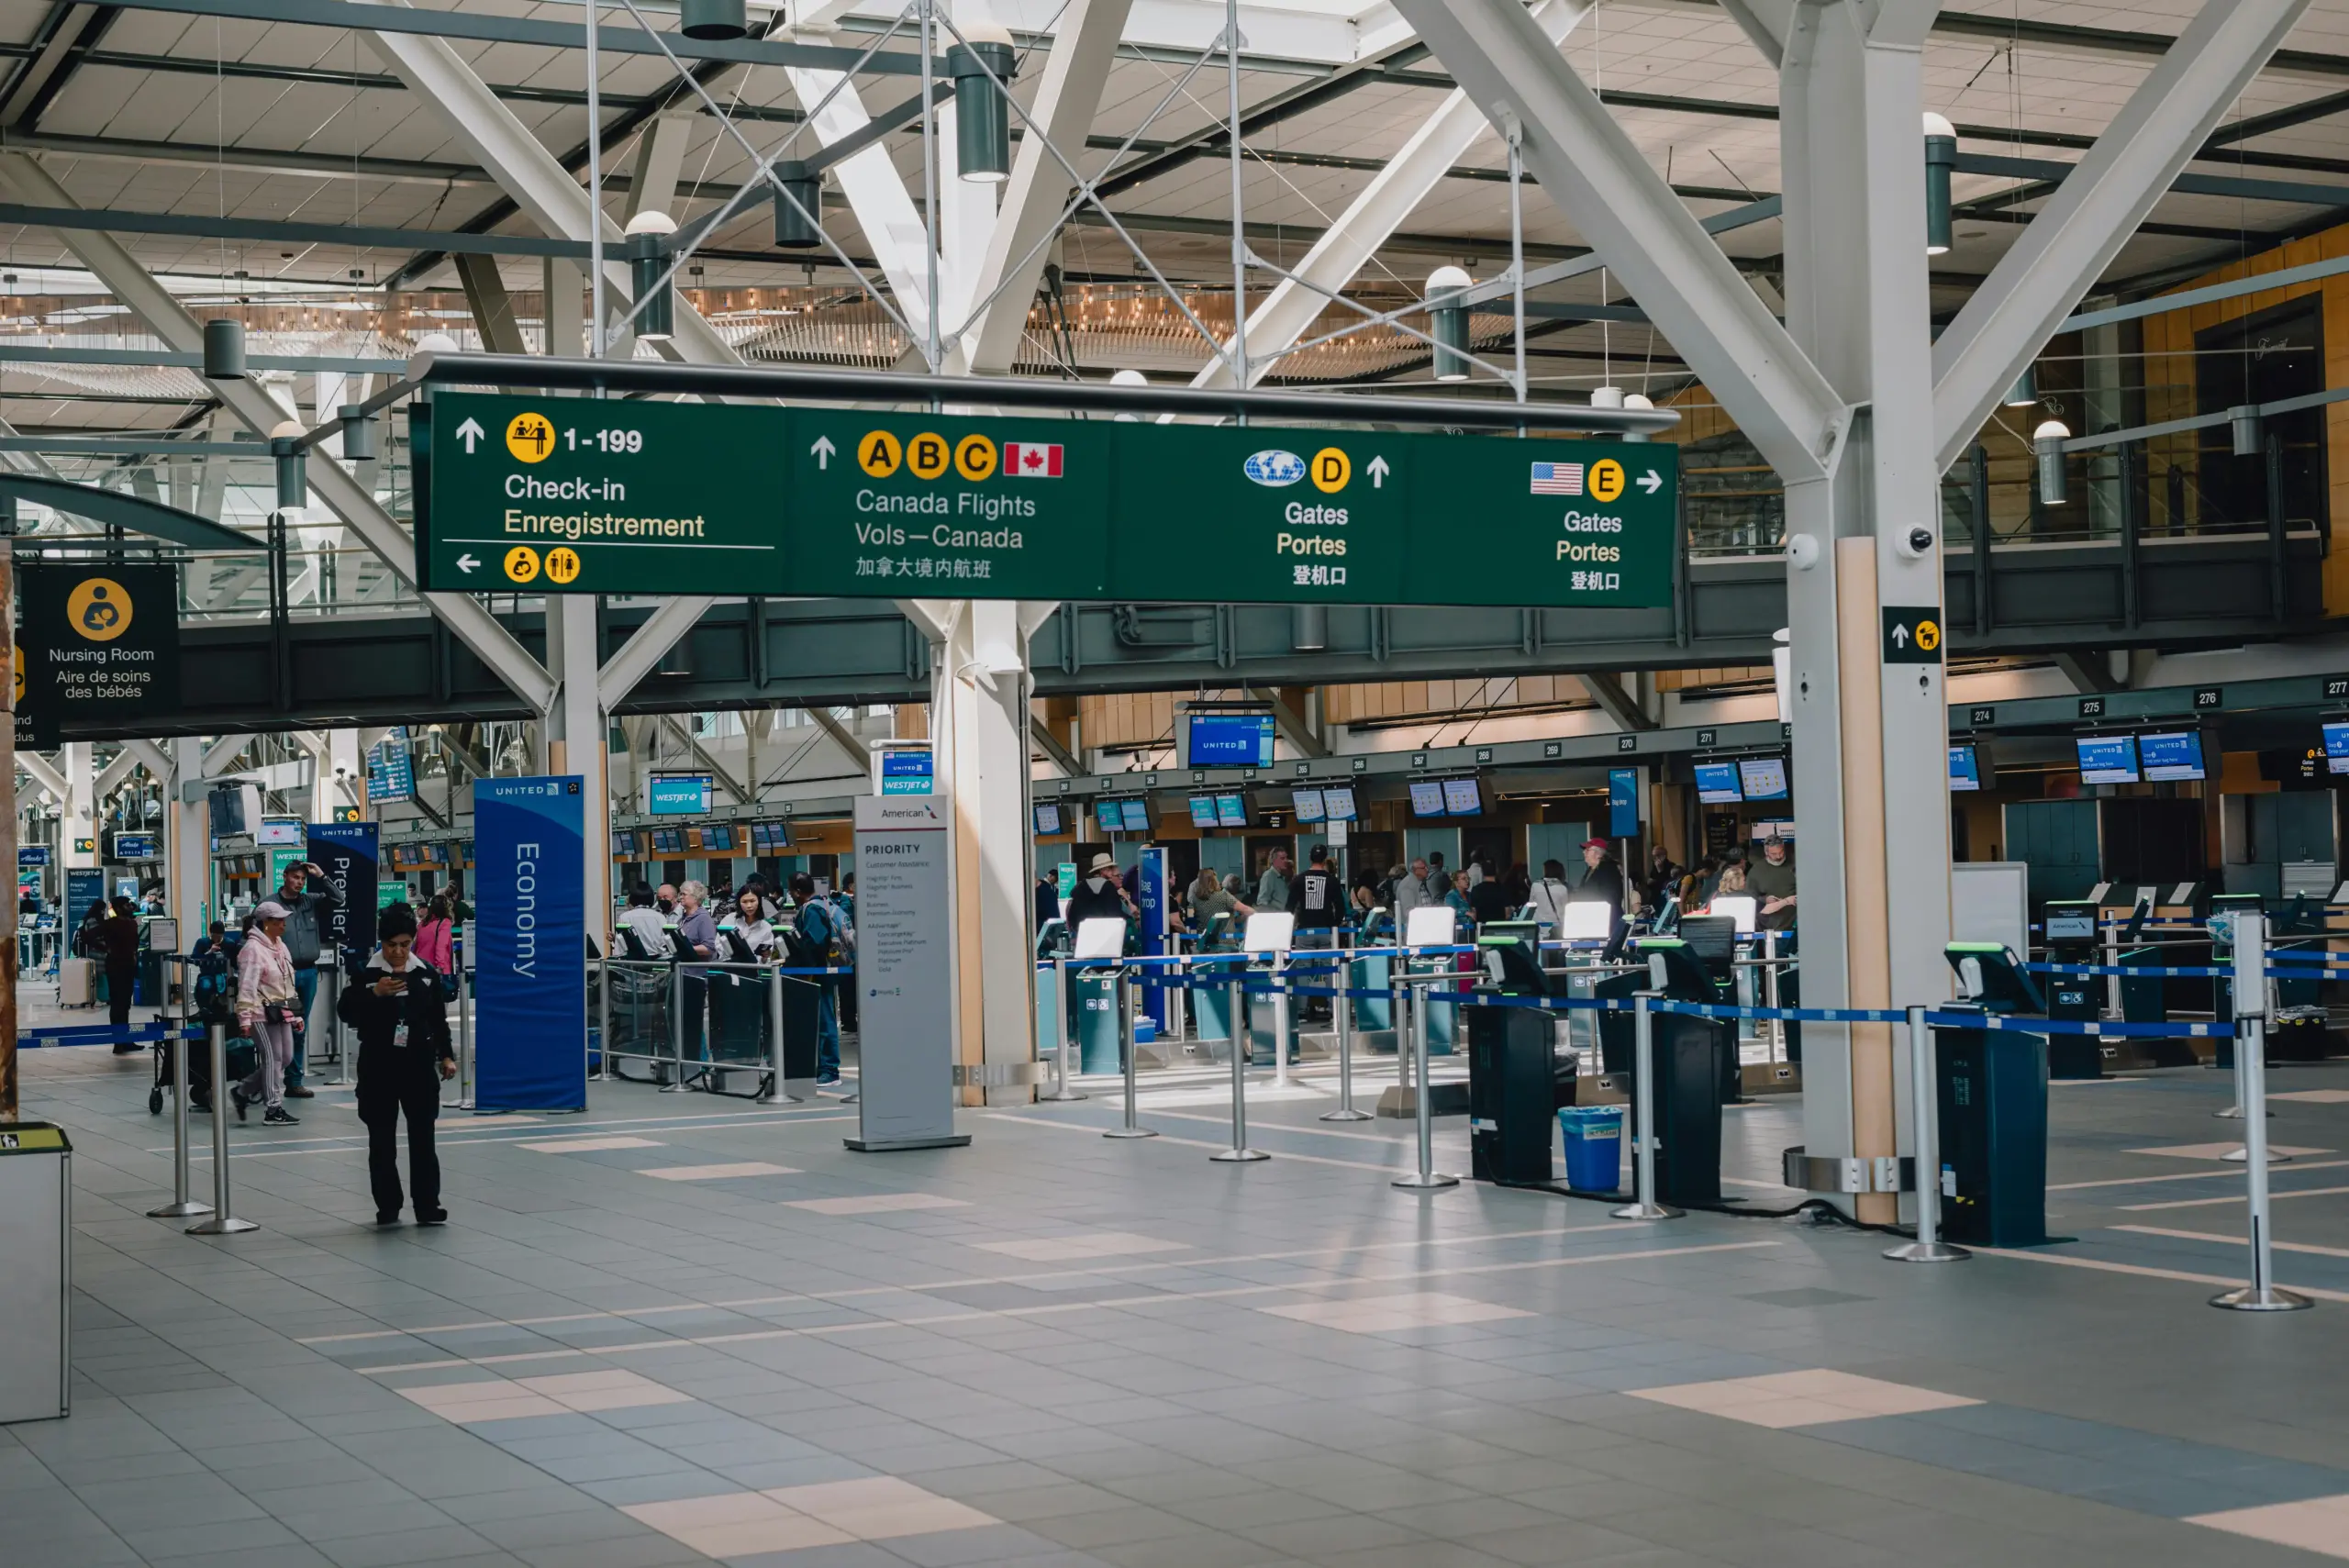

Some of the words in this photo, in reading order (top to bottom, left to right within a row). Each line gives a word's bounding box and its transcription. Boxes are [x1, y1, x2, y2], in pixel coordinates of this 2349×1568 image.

[564, 428, 642, 454] 1-199
[867, 439, 892, 468] A
[918, 440, 941, 470] B
[964, 442, 988, 472] C
[1322, 457, 1341, 484] D
[1598, 467, 1614, 493] E
[505, 473, 625, 501] Check-in
[856, 489, 949, 514] Canada
[958, 493, 1036, 521] Flights
[1285, 501, 1349, 526] Gates
[504, 510, 705, 539] Enregistrement
[1564, 510, 1622, 533] Gates
[1276, 532, 1347, 556] Portes
[1556, 539, 1620, 562] Portes
[855, 556, 991, 579] 加拿大境内航班
[1293, 564, 1346, 586] 登机口
[1570, 571, 1620, 591] 登机口
[50, 649, 106, 663] Nursing
[111, 648, 155, 662] Room
[56, 671, 86, 684] Aire
[89, 671, 108, 683] de
[112, 671, 151, 683] soins
[65, 685, 93, 698] des
[96, 684, 142, 698] bébés
[2329, 682, 2348, 694] 277
[2199, 693, 2216, 704] 276
[2084, 702, 2099, 713] 275
[1975, 711, 1990, 721] 274
[1621, 738, 1633, 749] 270
[1701, 733, 1712, 743] 271
[1478, 751, 1489, 761] 268
[1546, 745, 1558, 755] 269
[1354, 760, 1364, 770] 266
[1414, 755, 1424, 766] 267
[1298, 764, 1308, 773] 265
[495, 786, 544, 795] UNITED
[885, 782, 921, 791] WESTJET
[655, 794, 689, 804] WESTJET
[882, 809, 924, 818] American
[865, 844, 920, 854] PRIORITY
[513, 842, 540, 979] Economy
